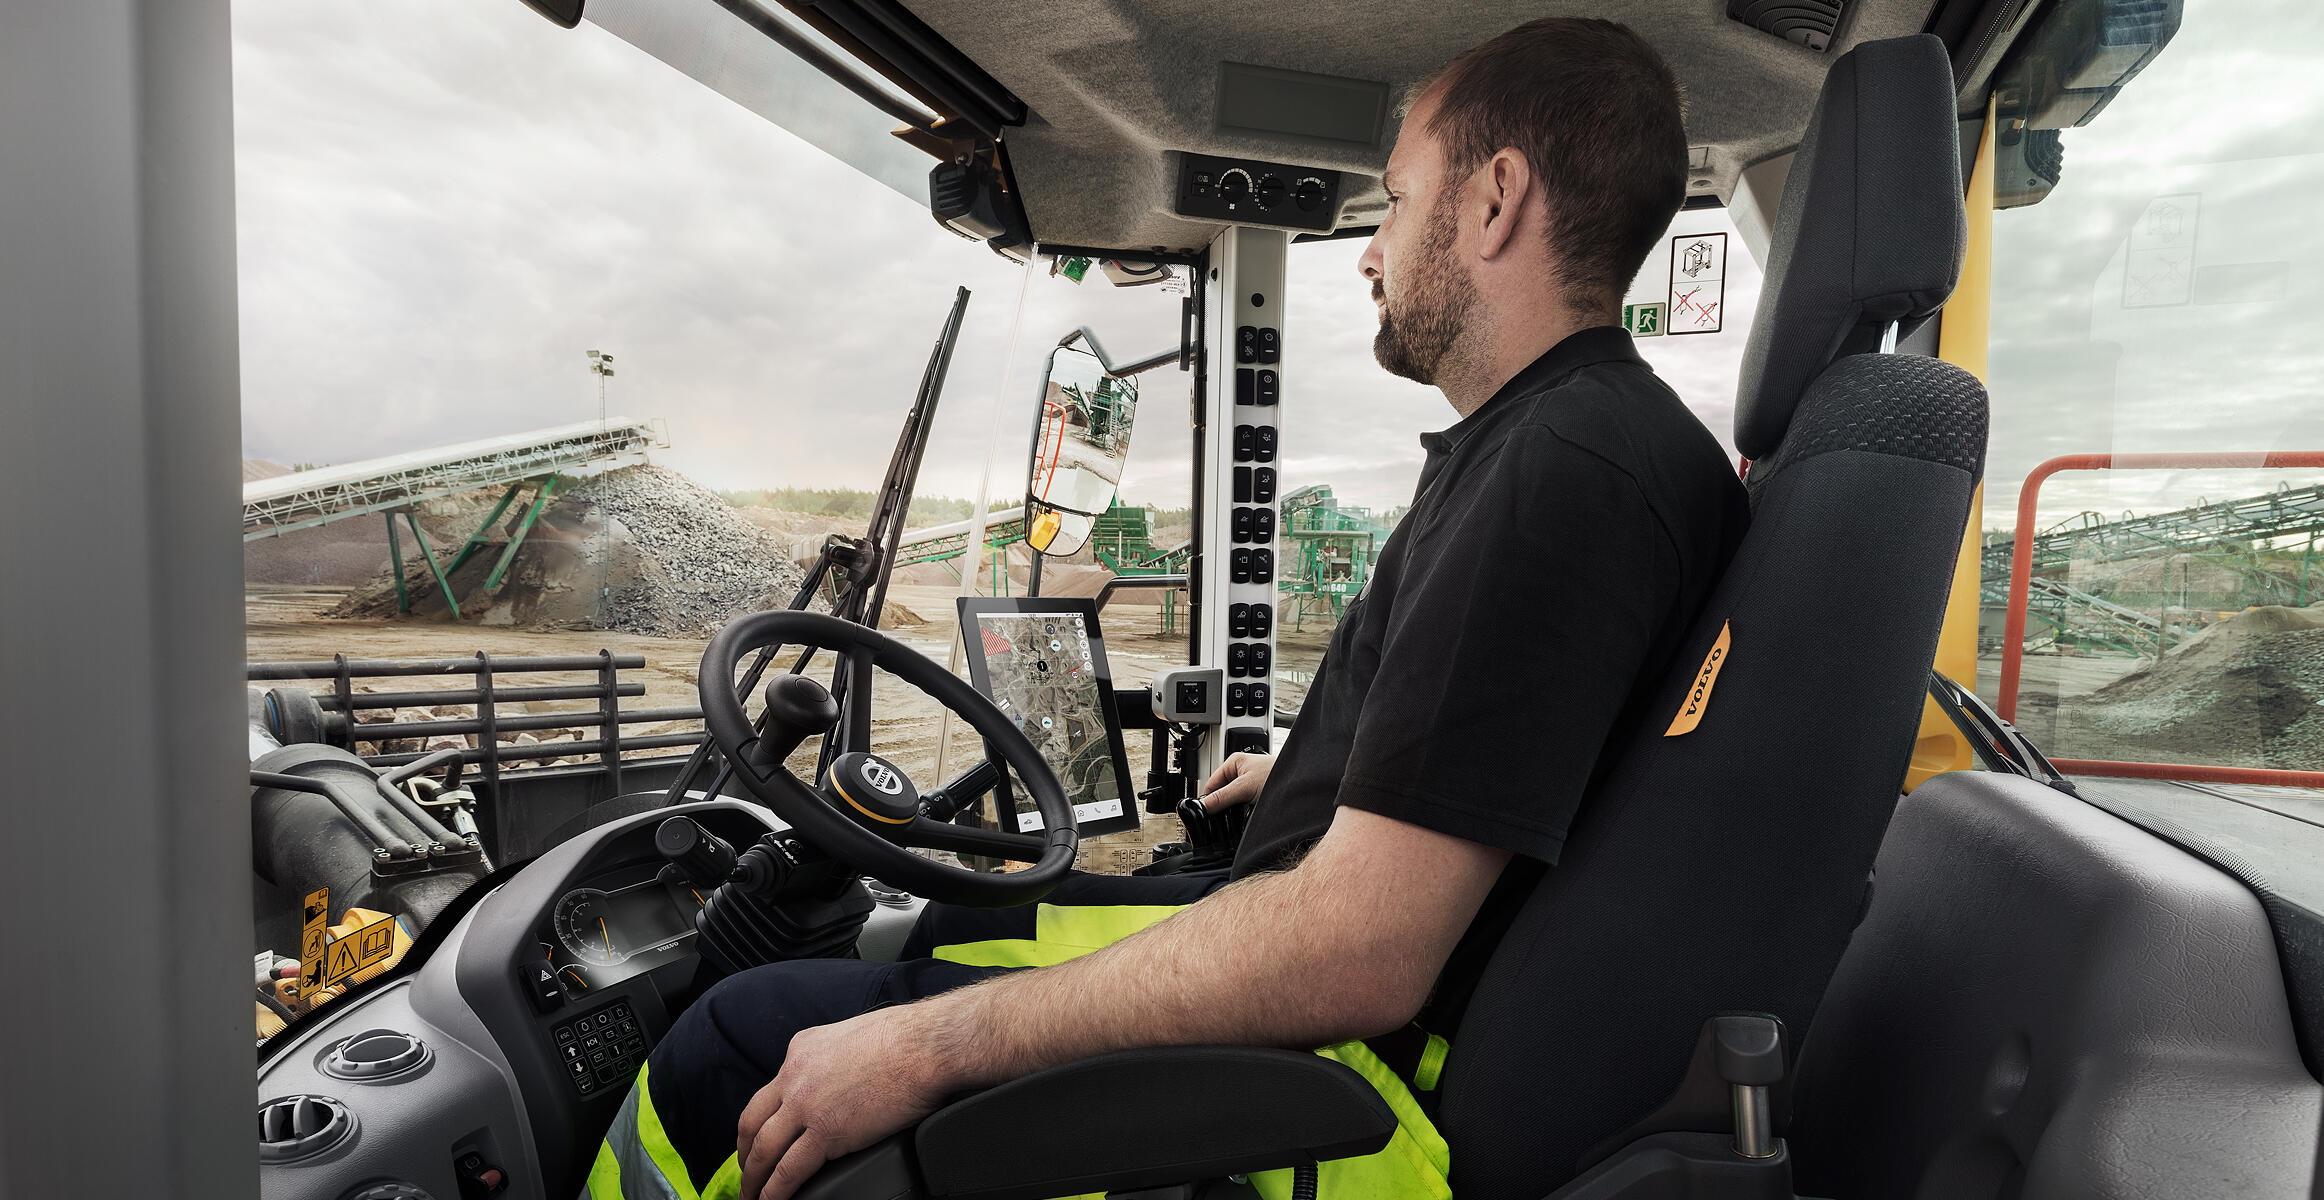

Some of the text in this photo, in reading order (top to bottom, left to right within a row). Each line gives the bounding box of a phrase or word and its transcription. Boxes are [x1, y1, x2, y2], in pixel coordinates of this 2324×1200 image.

[1331, 583, 1347, 593] 640
[1685, 648, 1722, 716] VOLVO
[875, 767, 890, 788] VOLVO
[657, 941, 679, 953] VOLVO
